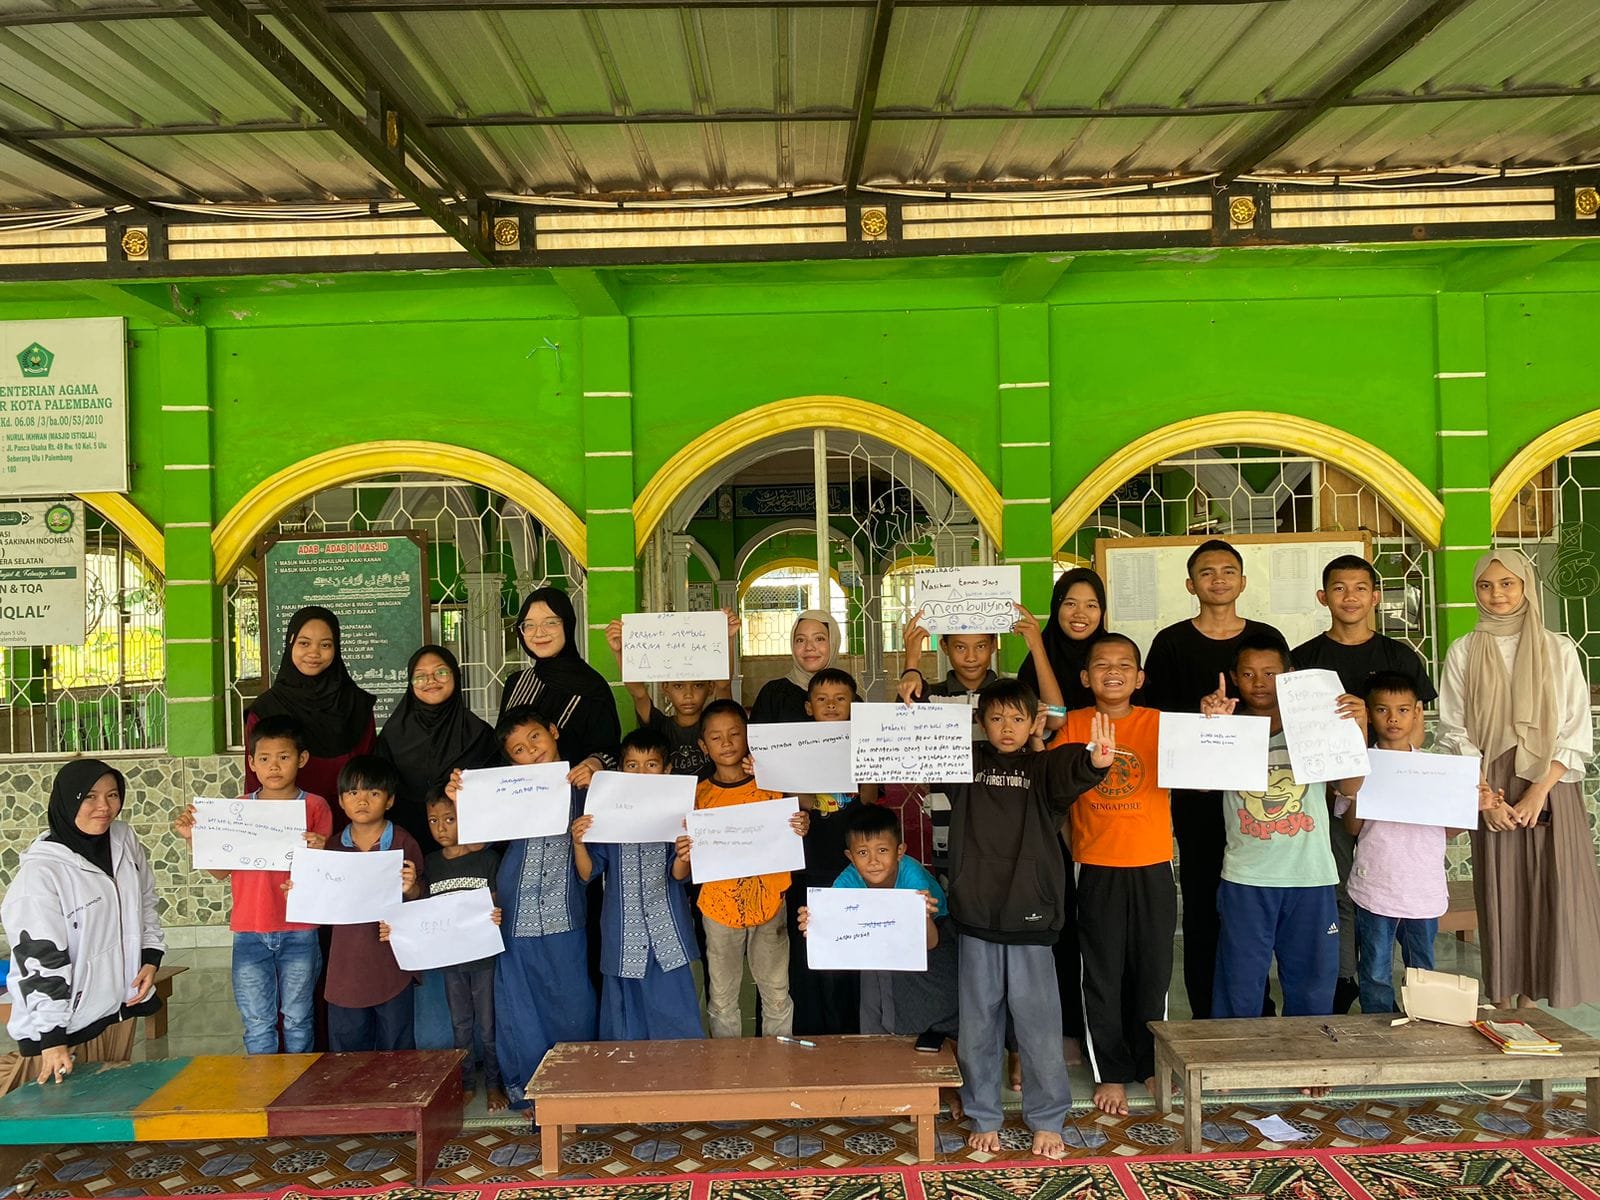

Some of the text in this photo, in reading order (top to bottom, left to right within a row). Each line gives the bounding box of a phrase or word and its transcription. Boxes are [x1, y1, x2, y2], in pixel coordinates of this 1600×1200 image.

[58, 383, 99, 396] AGAMA
[10, 399, 42, 411] KOTA
[44, 397, 113, 410] PALEMBANG
[14, 416, 35, 427] 06.08
[45, 454, 73, 462] Palembang
[36, 536, 74, 544] INDONESIA
[298, 544, 320, 554] ADAB
[325, 543, 347, 553] ADAB
[347, 543, 357, 552] DI
[357, 542, 388, 552] MASJID
[20, 583, 43, 594] TQA
[1090, 802, 1142, 811] SINGAPORE
